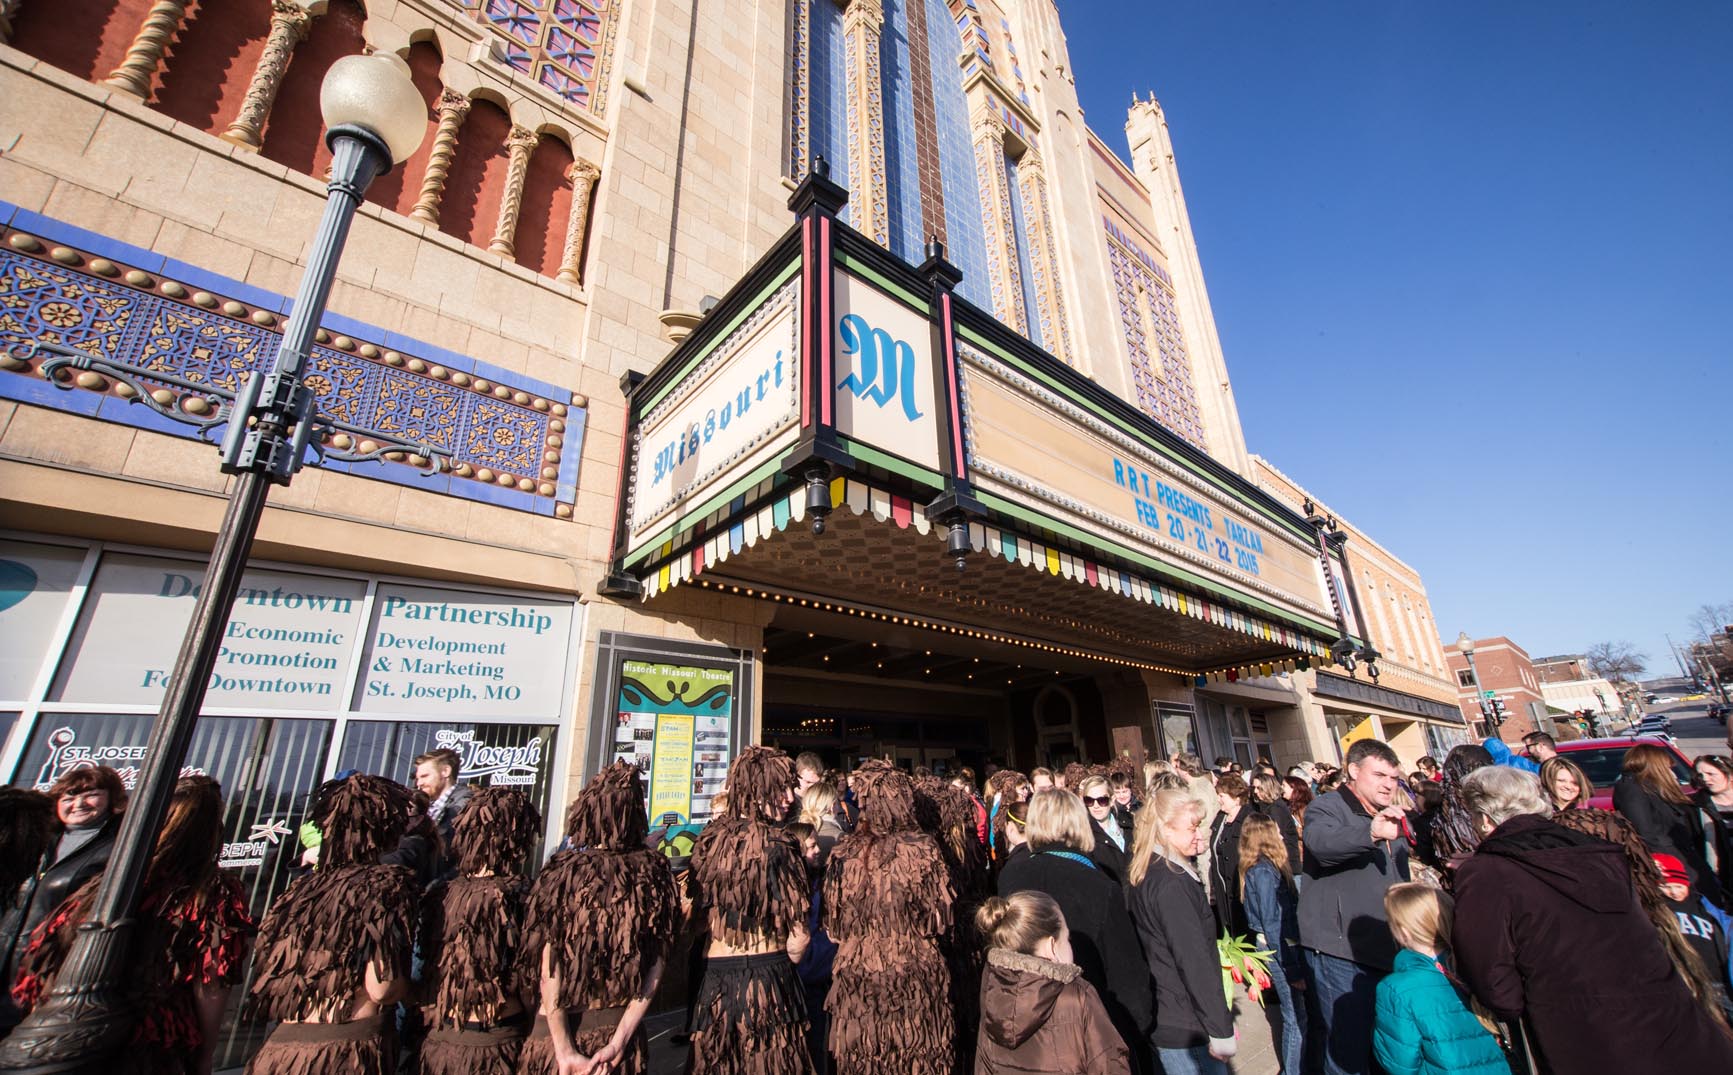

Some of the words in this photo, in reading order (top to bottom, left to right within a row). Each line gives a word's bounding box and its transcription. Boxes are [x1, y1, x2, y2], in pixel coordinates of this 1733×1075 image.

[837, 313, 924, 422] M
[651, 350, 784, 488] Missouri
[1156, 481, 1213, 529] PRESENTS
[1224, 517, 1264, 556] TARZAN
[1135, 498, 1160, 530] FEB
[1234, 548, 1260, 575] 2015
[158, 573, 352, 613] Dntown
[383, 595, 552, 635] Partnership
[225, 621, 344, 645] Economic
[377, 632, 506, 655] Development
[217, 646, 337, 670] Promotion
[373, 656, 392, 672] &
[400, 657, 504, 681] Marketing
[623, 662, 657, 675] Historic
[661, 667, 697, 678] Missouri
[207, 672, 332, 695] Downtown
[367, 680, 395, 697] St.
[401, 681, 477, 702] Joseph,
[484, 684, 521, 701] MO
[436, 730, 459, 741] City
[460, 730, 475, 741] of
[62, 746, 91, 760] ST.
[92, 746, 148, 760] JOSE
[460, 737, 541, 774] Joseph
[490, 773, 536, 786] Missouri
[220, 841, 267, 858] SEPH
